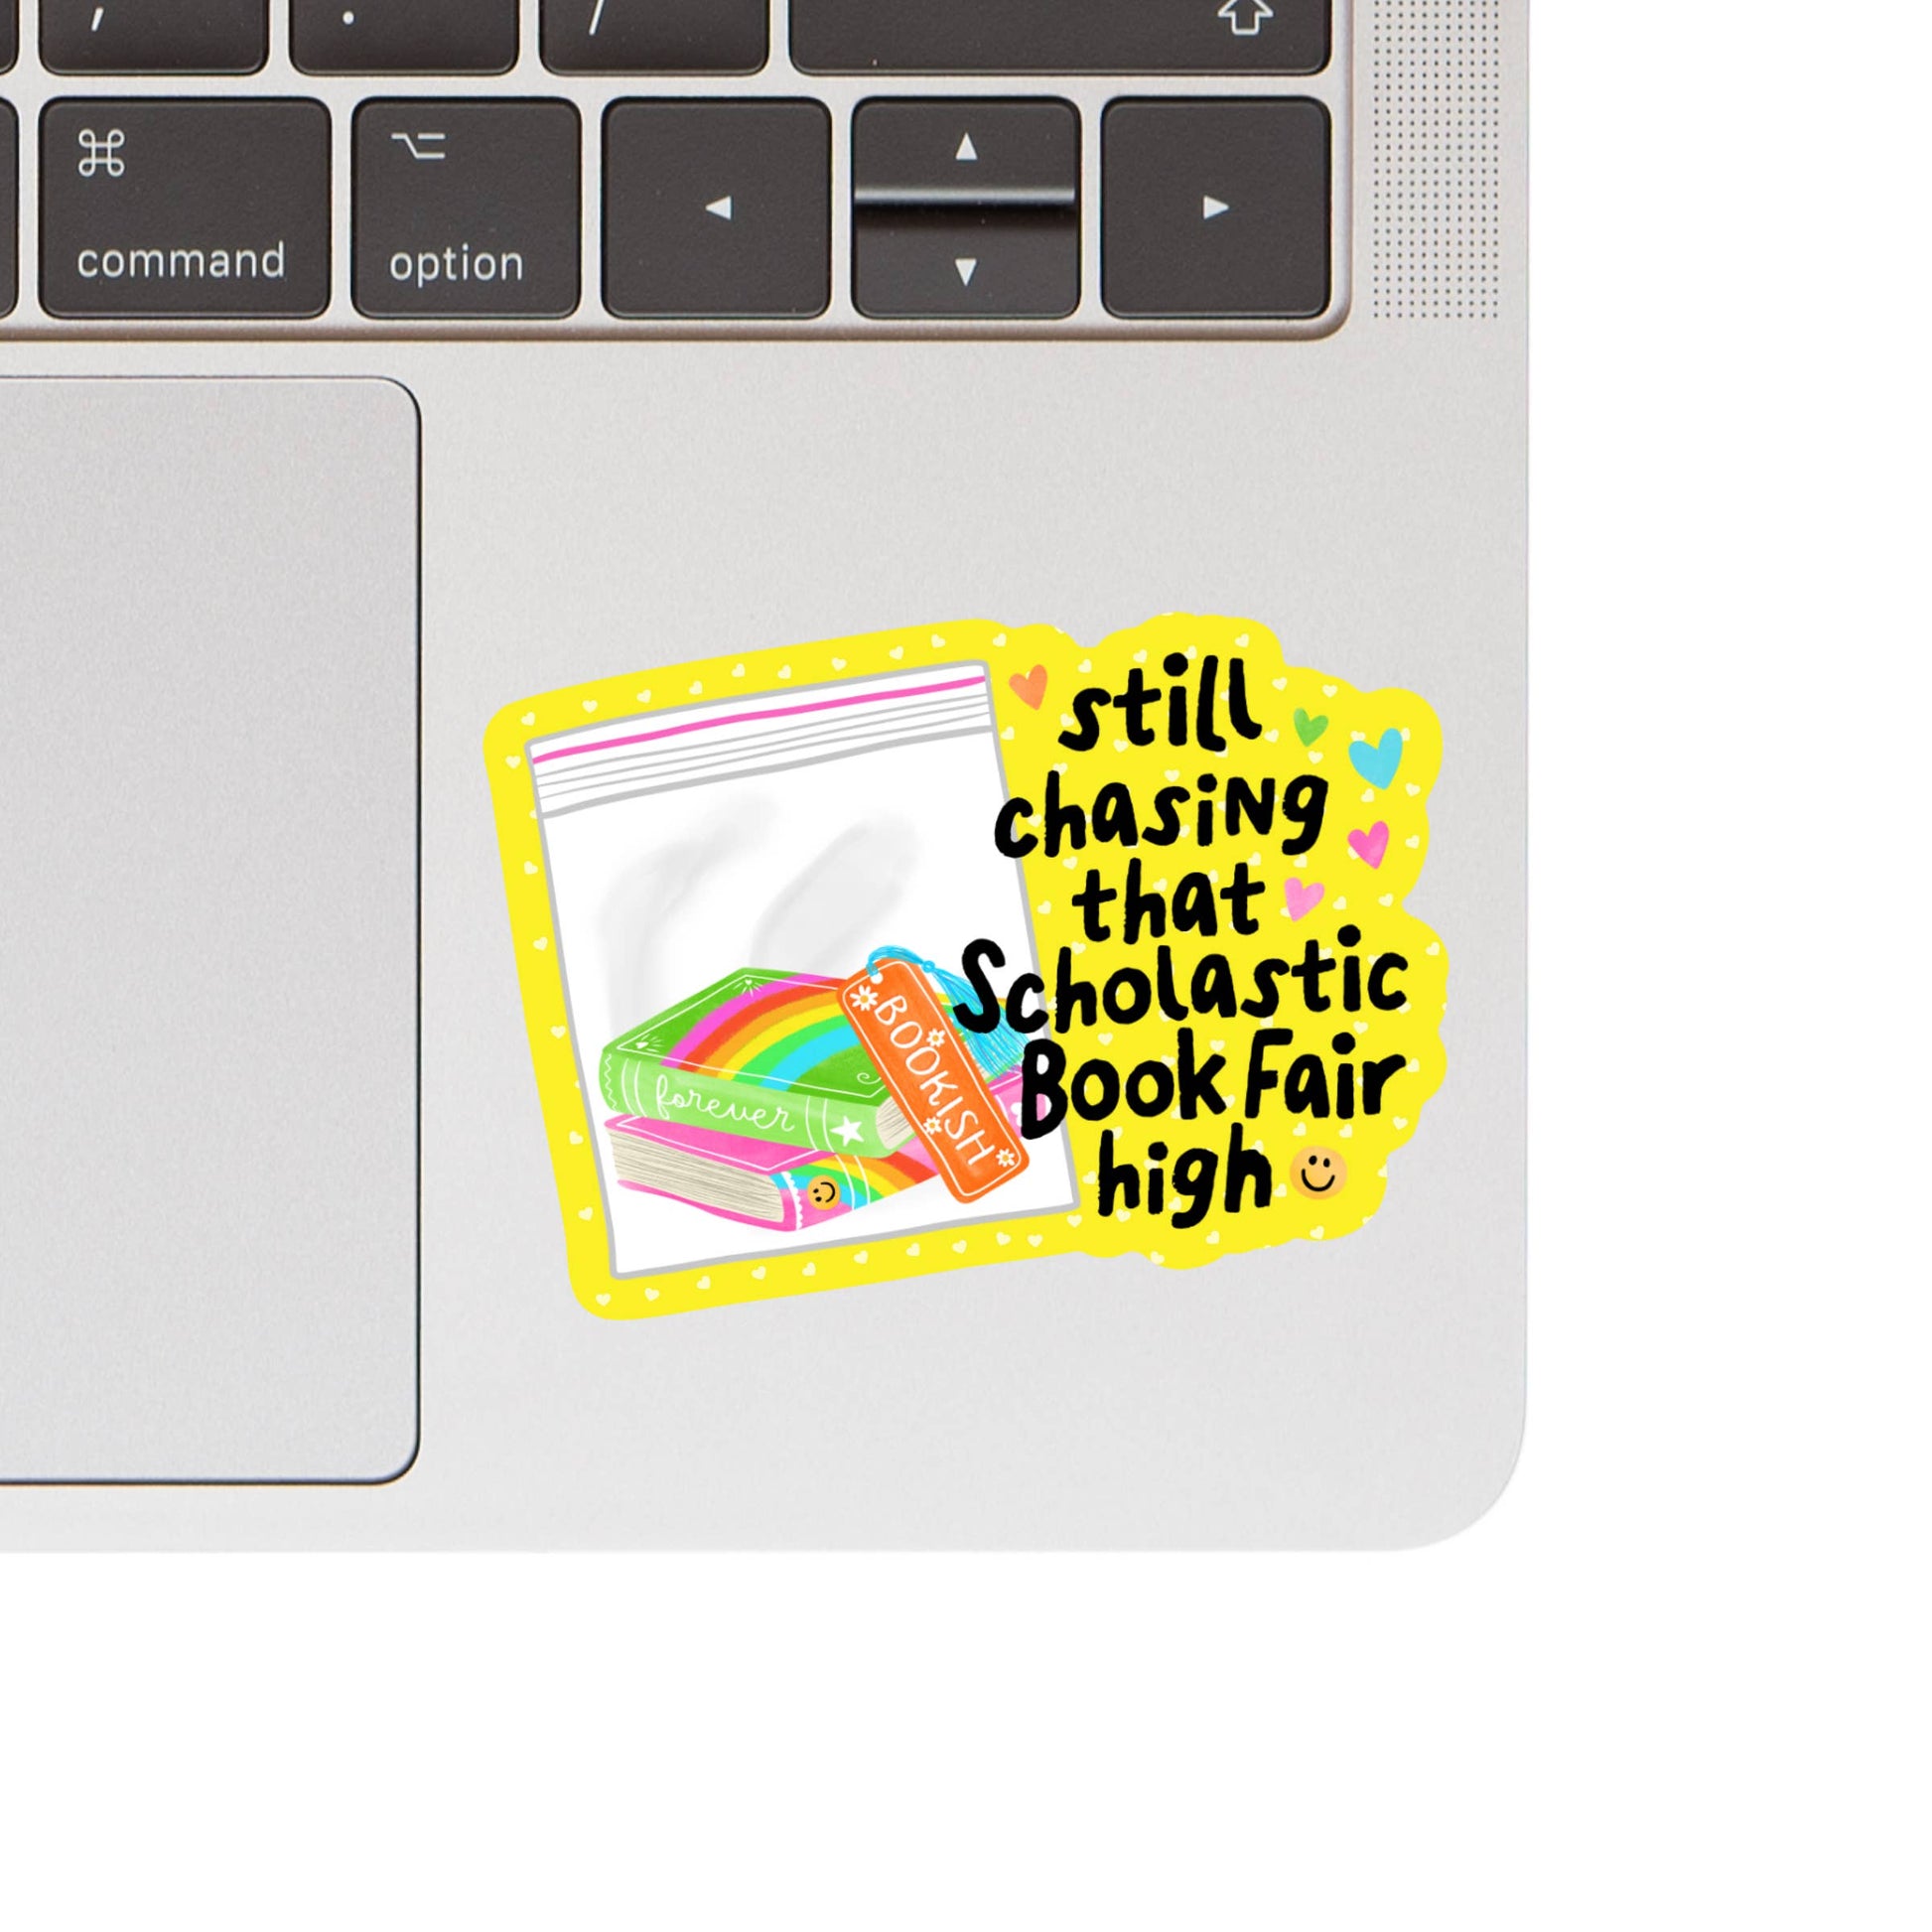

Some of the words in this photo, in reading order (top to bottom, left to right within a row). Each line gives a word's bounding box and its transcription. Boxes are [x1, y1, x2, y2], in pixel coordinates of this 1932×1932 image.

[77, 239, 285, 279] command
[389, 242, 523, 289] option
[1058, 652, 1262, 752] still
[1072, 858, 1265, 945] that
[953, 924, 1409, 1035] Scholastic
[655, 1074, 795, 1132] forever
[874, 995, 996, 1167] BOOKISH
[1022, 1027, 1227, 1141] Book
[1245, 1028, 1407, 1120] Fair
[1099, 1122, 1272, 1229] high
